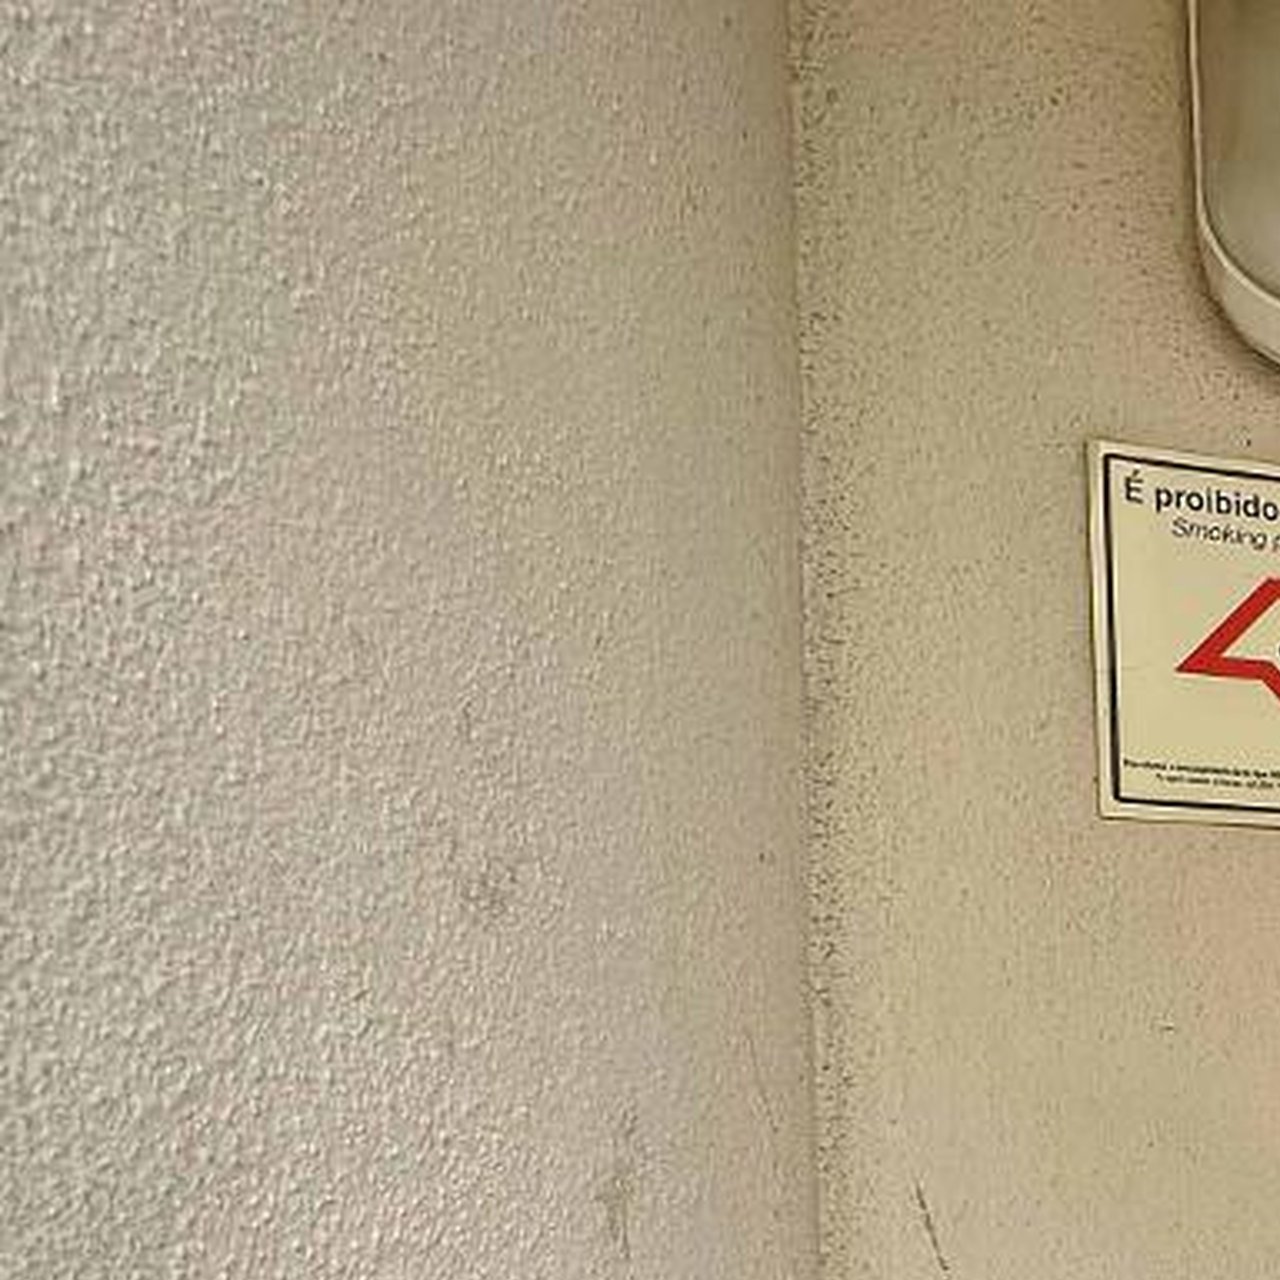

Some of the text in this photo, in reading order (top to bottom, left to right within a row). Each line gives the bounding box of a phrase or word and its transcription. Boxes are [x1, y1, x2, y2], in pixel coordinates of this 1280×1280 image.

[1125, 470, 1144, 505] É
[1155, 487, 1280, 521] proibido
[1171, 516, 1267, 550] Smoking
